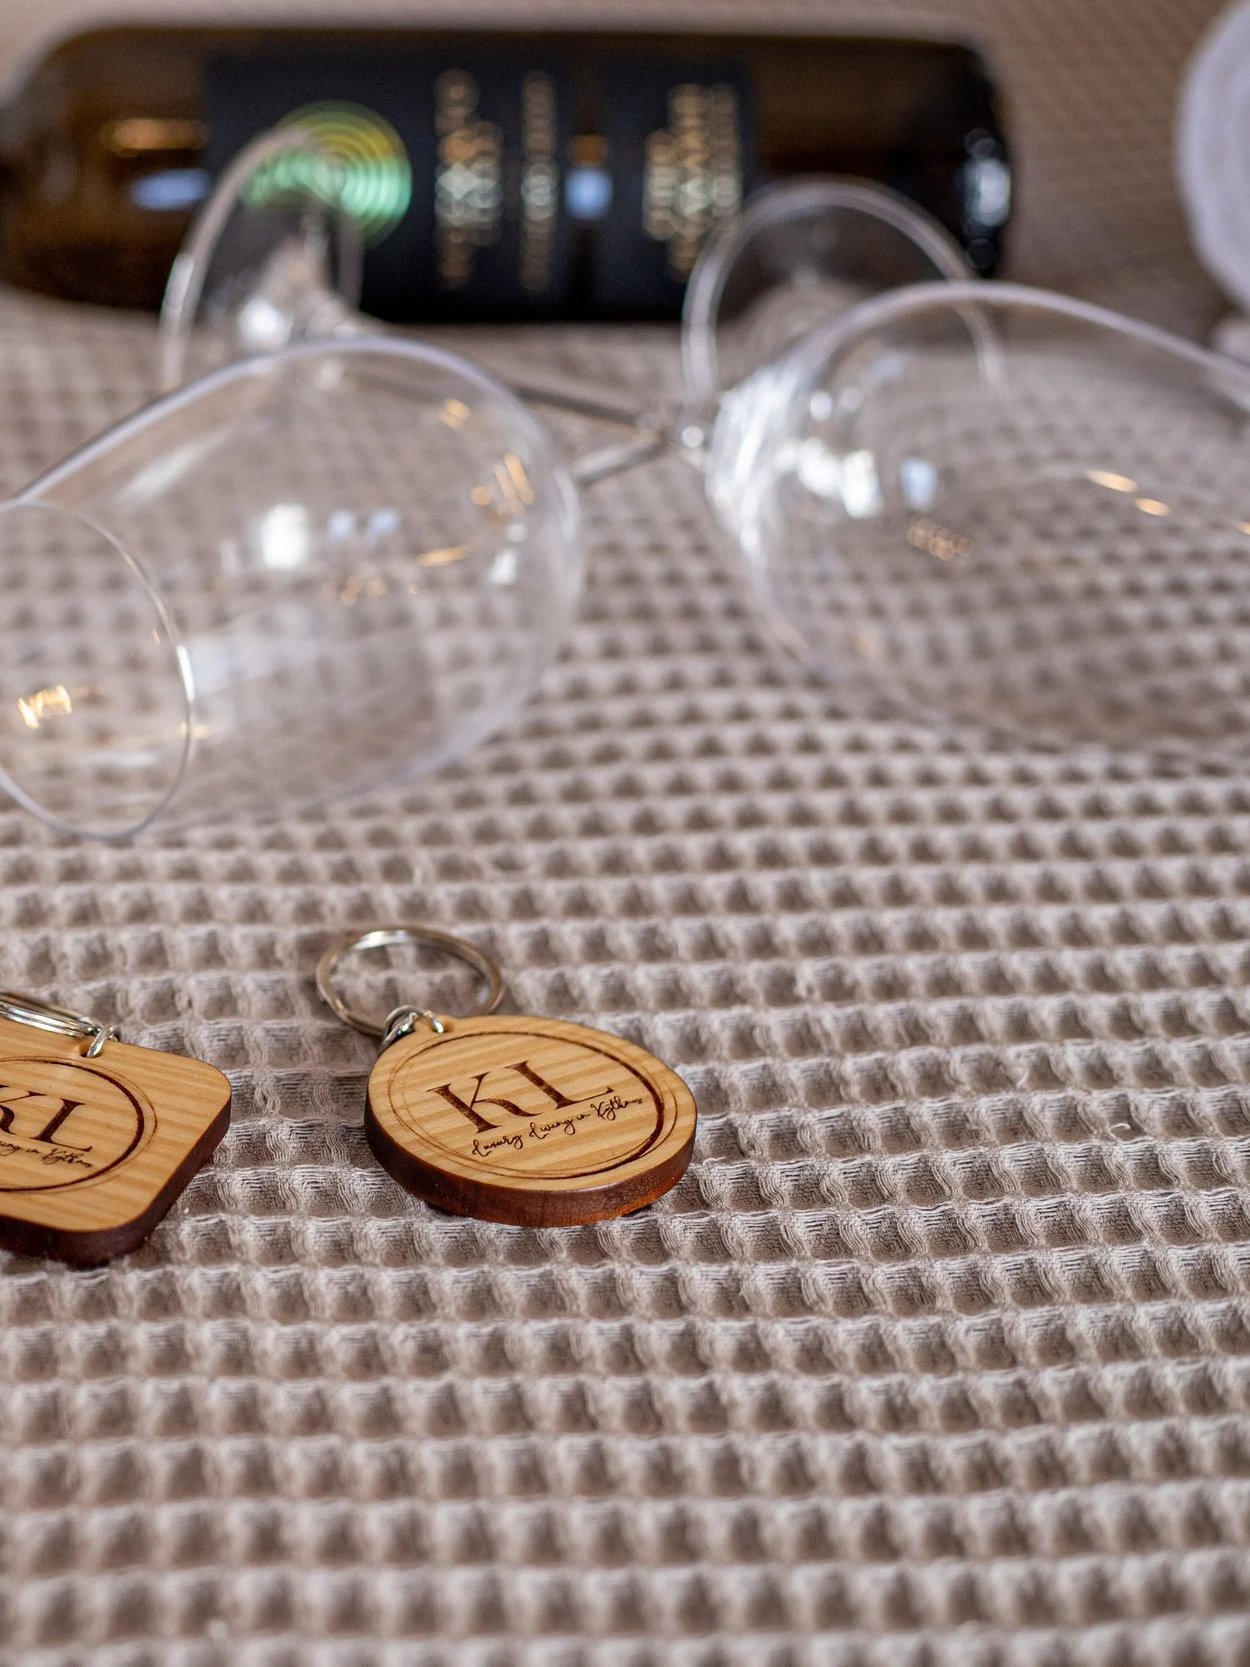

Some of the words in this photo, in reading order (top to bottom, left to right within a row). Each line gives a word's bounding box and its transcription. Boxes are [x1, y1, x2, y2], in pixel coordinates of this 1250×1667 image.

[426, 1060, 615, 1133] KL
[471, 1134, 524, 1157] Luxury
[528, 1118, 576, 1139] Living
